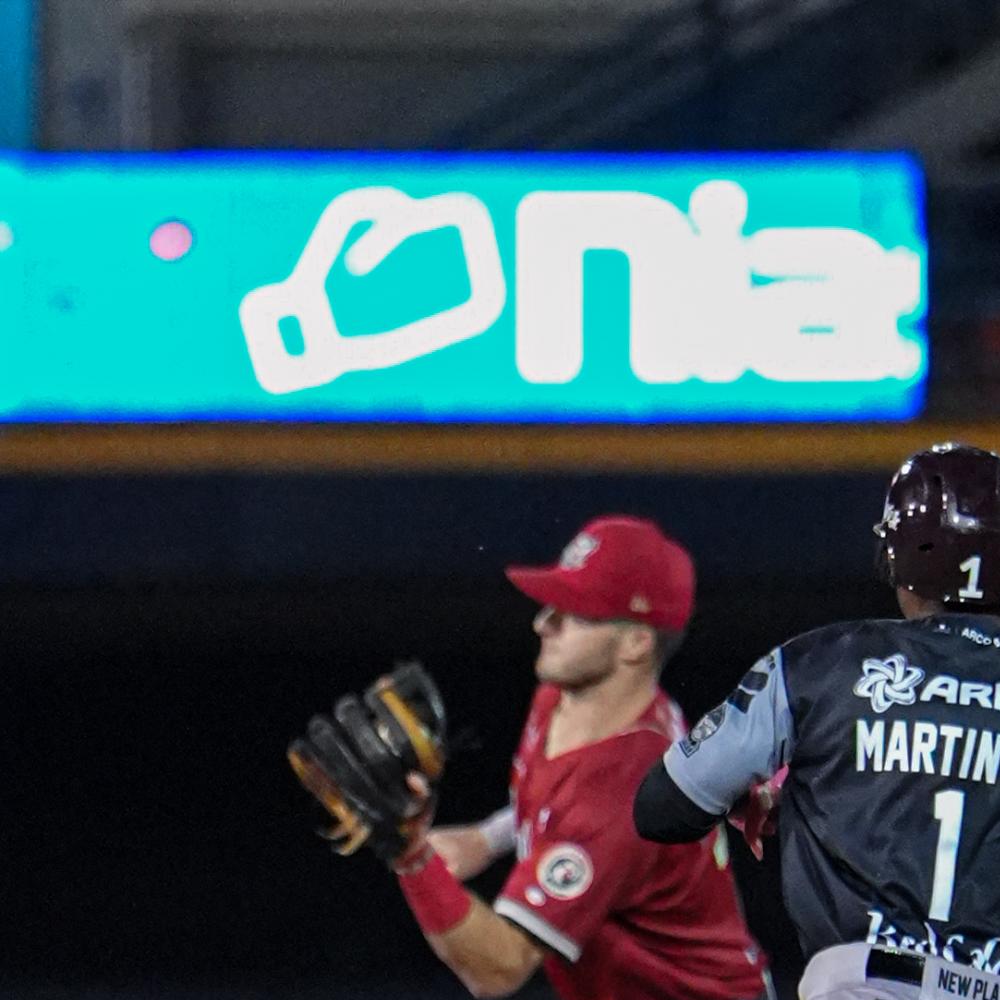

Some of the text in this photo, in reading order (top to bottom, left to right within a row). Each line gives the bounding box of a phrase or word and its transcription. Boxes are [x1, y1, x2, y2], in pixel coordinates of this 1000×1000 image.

[958, 556, 984, 599] 1
[928, 789, 966, 923] 1
[937, 967, 972, 998] NEW
